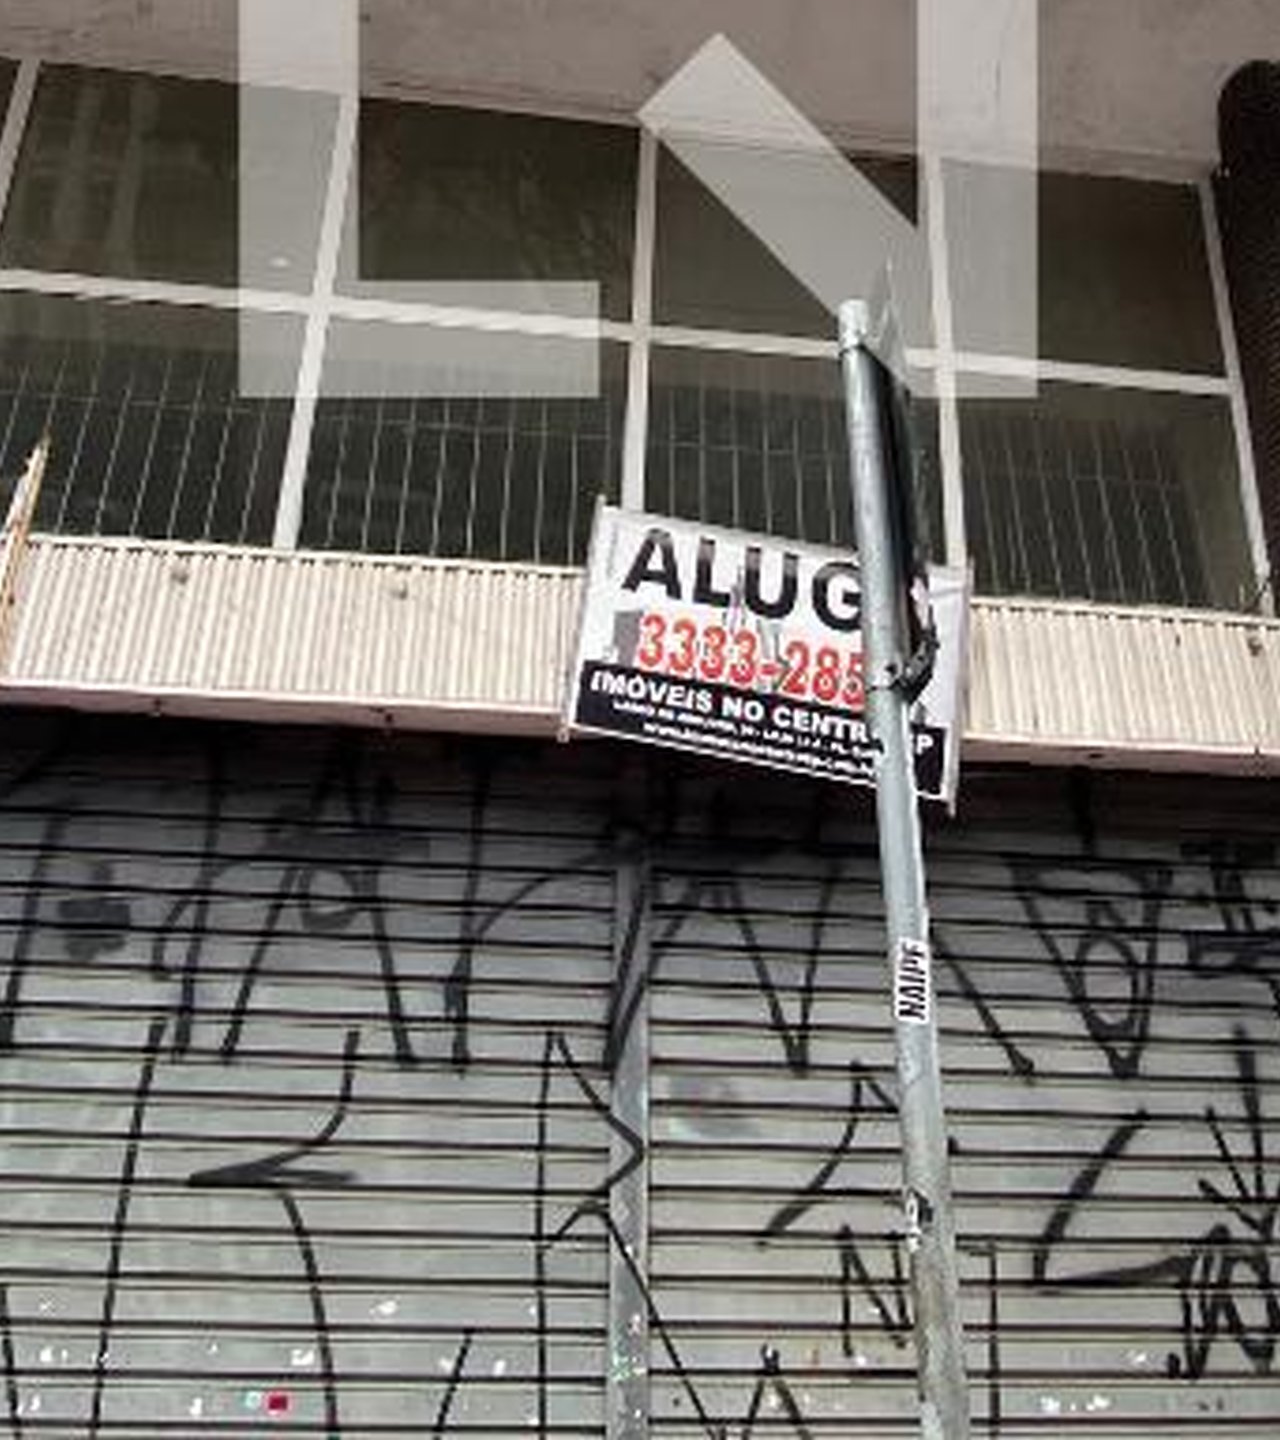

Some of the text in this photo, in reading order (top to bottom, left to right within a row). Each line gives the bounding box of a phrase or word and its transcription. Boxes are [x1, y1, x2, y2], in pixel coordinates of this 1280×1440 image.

[621, 528, 863, 631] ALUG
[638, 613, 866, 707] 3333-285
[721, 698, 764, 721] NO
[773, 706, 878, 745] CENTR
